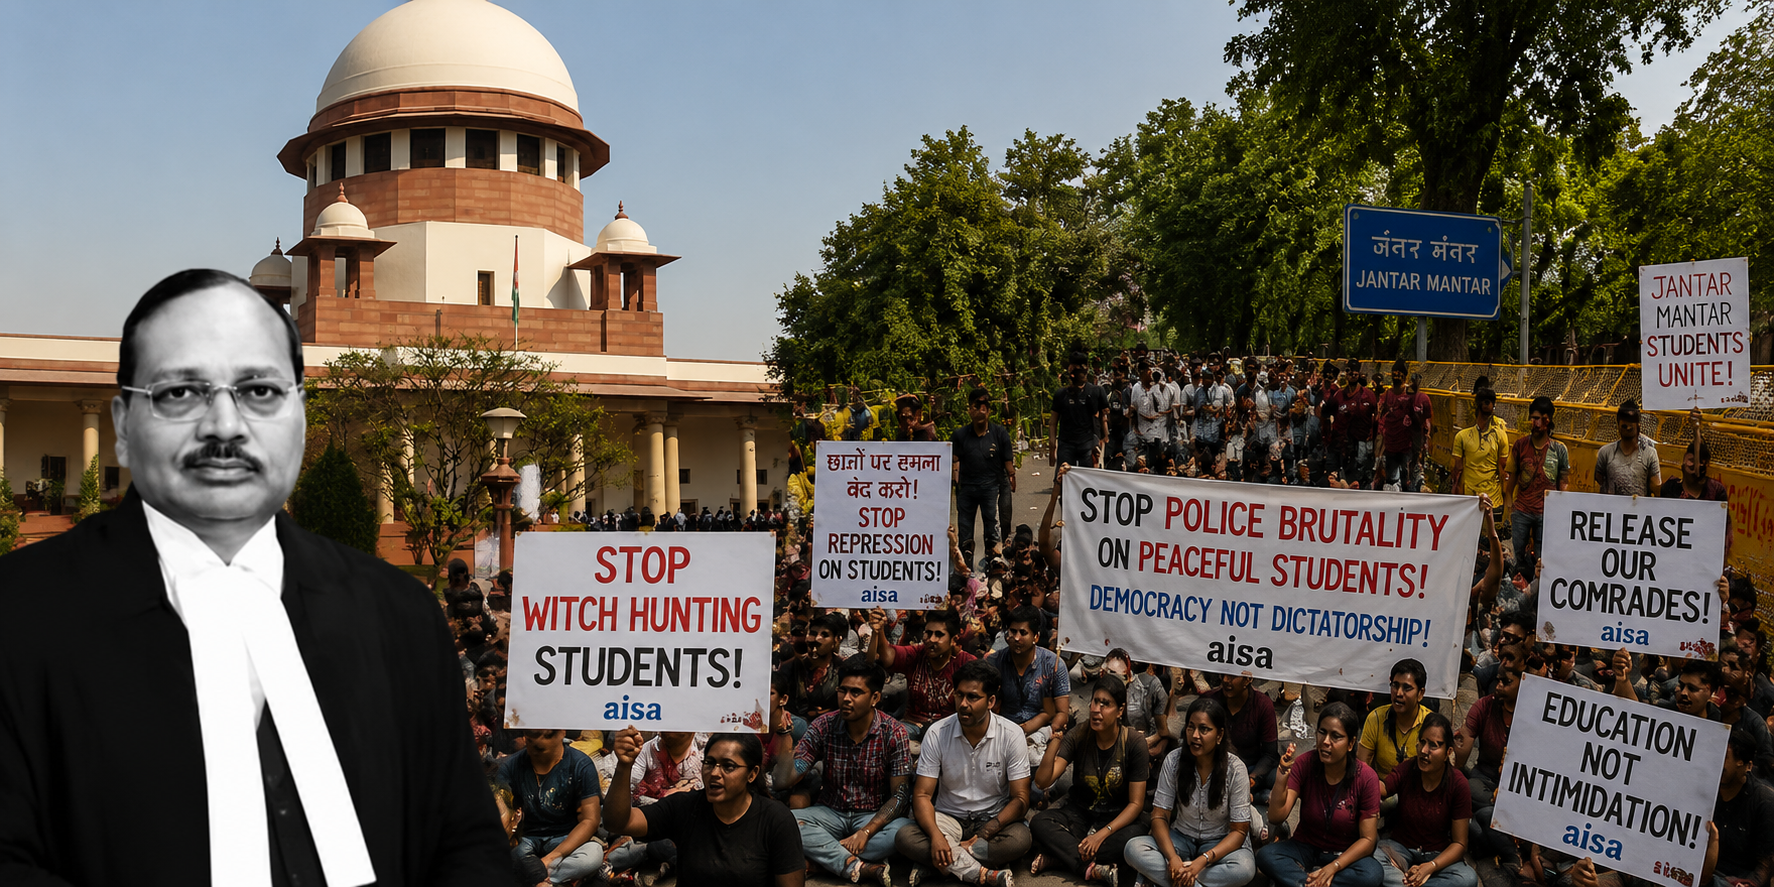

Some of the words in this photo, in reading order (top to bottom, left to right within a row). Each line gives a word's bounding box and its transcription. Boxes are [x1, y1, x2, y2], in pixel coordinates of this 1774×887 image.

[1356, 269, 1421, 291] JANTAR
[1427, 274, 1491, 296] MANTAR
[1650, 272, 1733, 300] JANTAR
[1656, 302, 1733, 328] MANTAR
[1646, 331, 1744, 358] STUDENTS
[1658, 360, 1734, 388] UNITE!
[870, 454, 893, 471] पर
[858, 507, 906, 528] STOP
[1080, 487, 1153, 527] STOP
[1164, 496, 1265, 538] POLICE
[1278, 505, 1450, 551] BRUTALITY
[1569, 510, 1694, 550] RELEASE
[828, 533, 933, 555] REPRESSION
[594, 546, 691, 584] STOP
[819, 559, 842, 580] ON
[847, 559, 941, 582] STUDENTS!
[1098, 536, 1130, 570] ON
[1138, 541, 1260, 584] PEACEFUL
[1270, 553, 1429, 599] STUDENTS!
[1601, 547, 1656, 581] OUR
[861, 585, 898, 603] aisa
[1549, 577, 1711, 624] COMRADES!
[522, 596, 618, 632] WITCH
[629, 596, 762, 633] HUNTING
[1089, 584, 1212, 624] DEMOCRACY
[1220, 600, 1264, 630] NOT
[1271, 609, 1431, 648] DICTATORSHIP!
[1600, 621, 1650, 646] aisa
[533, 645, 743, 689] STUDENTS!
[1206, 635, 1274, 670] aisa
[603, 694, 662, 721] aisa
[1541, 691, 1697, 762] EDUCATION
[1580, 741, 1641, 786] NOT
[1507, 762, 1702, 850] INTIMIDATION!
[1562, 823, 1623, 861] aisa
